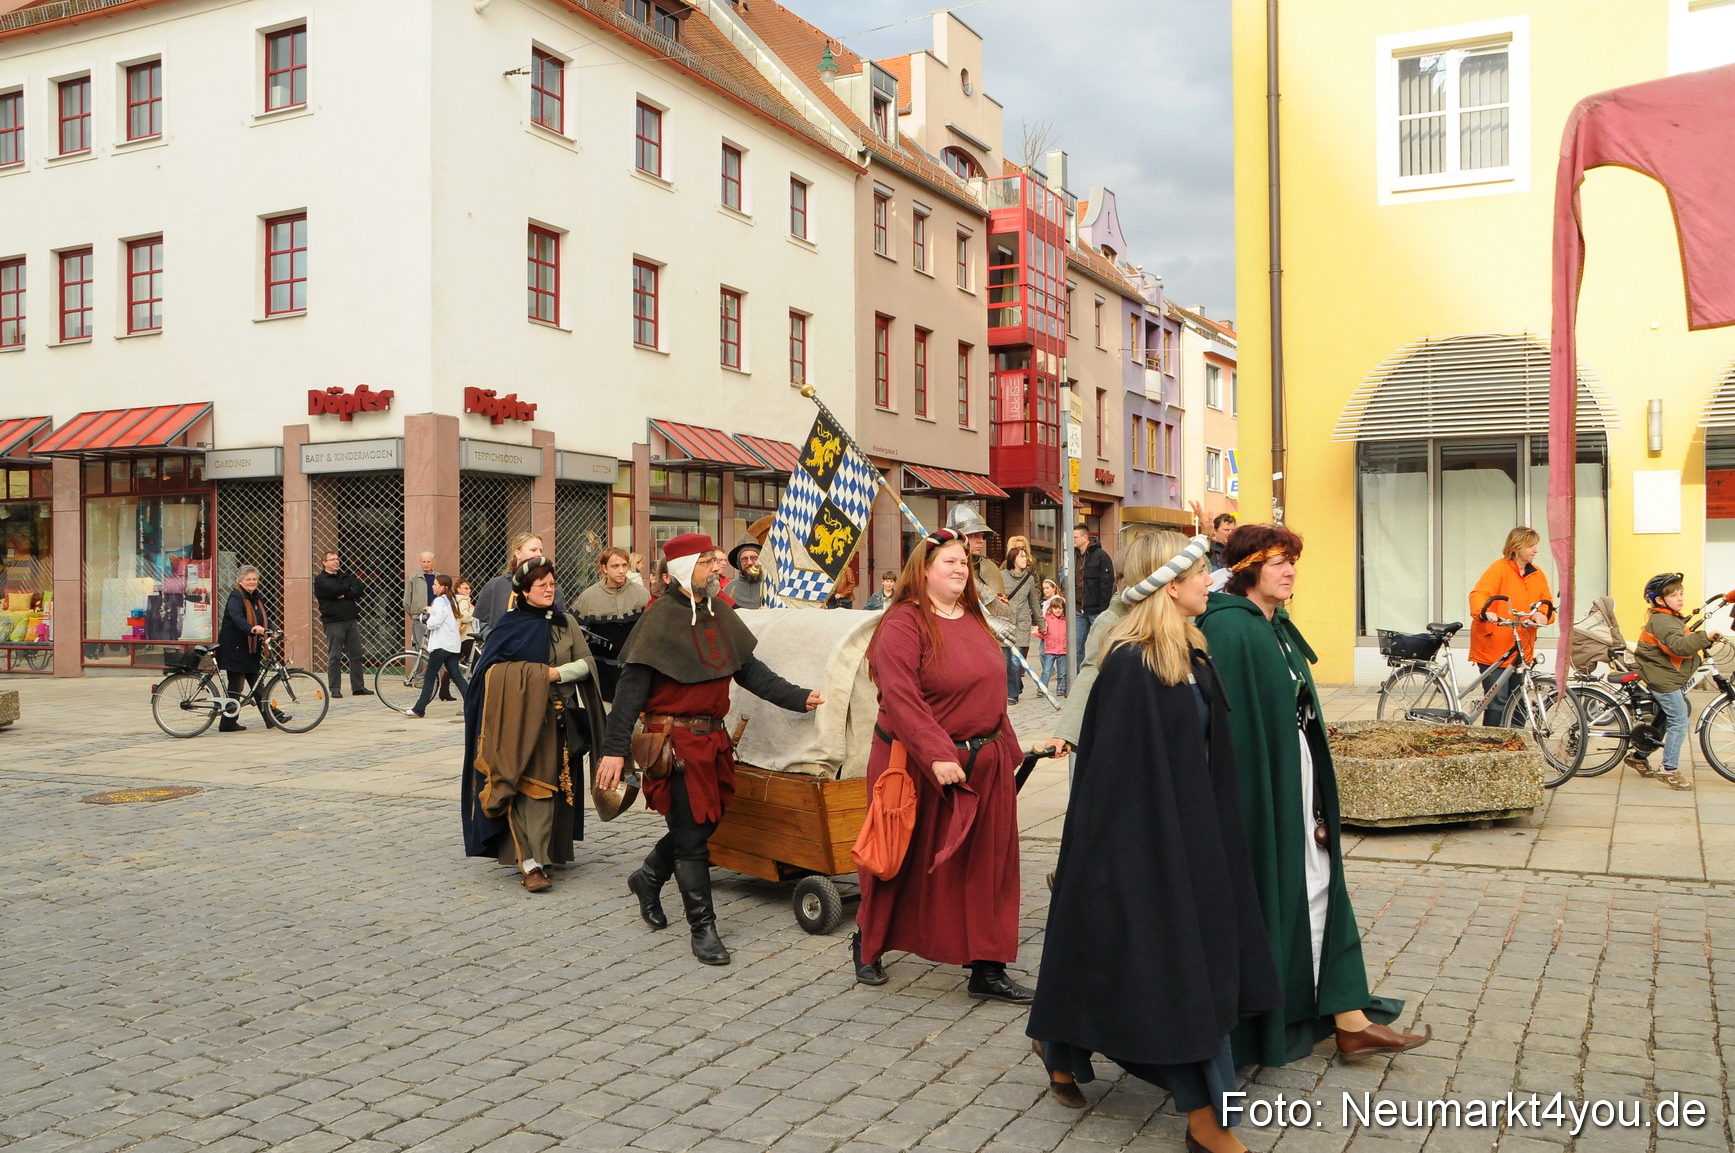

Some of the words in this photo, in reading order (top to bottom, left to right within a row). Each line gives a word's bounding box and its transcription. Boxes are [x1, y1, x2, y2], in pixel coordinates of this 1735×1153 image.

[308, 384, 394, 421] Döpfer
[465, 387, 537, 424] Döpfer
[1010, 378, 1021, 420] ESPRIT
[214, 459, 251, 469] GARDINEN
[305, 452, 324, 463] BABY
[326, 453, 332, 462] &
[334, 449, 393, 462] KINDERMODEN
